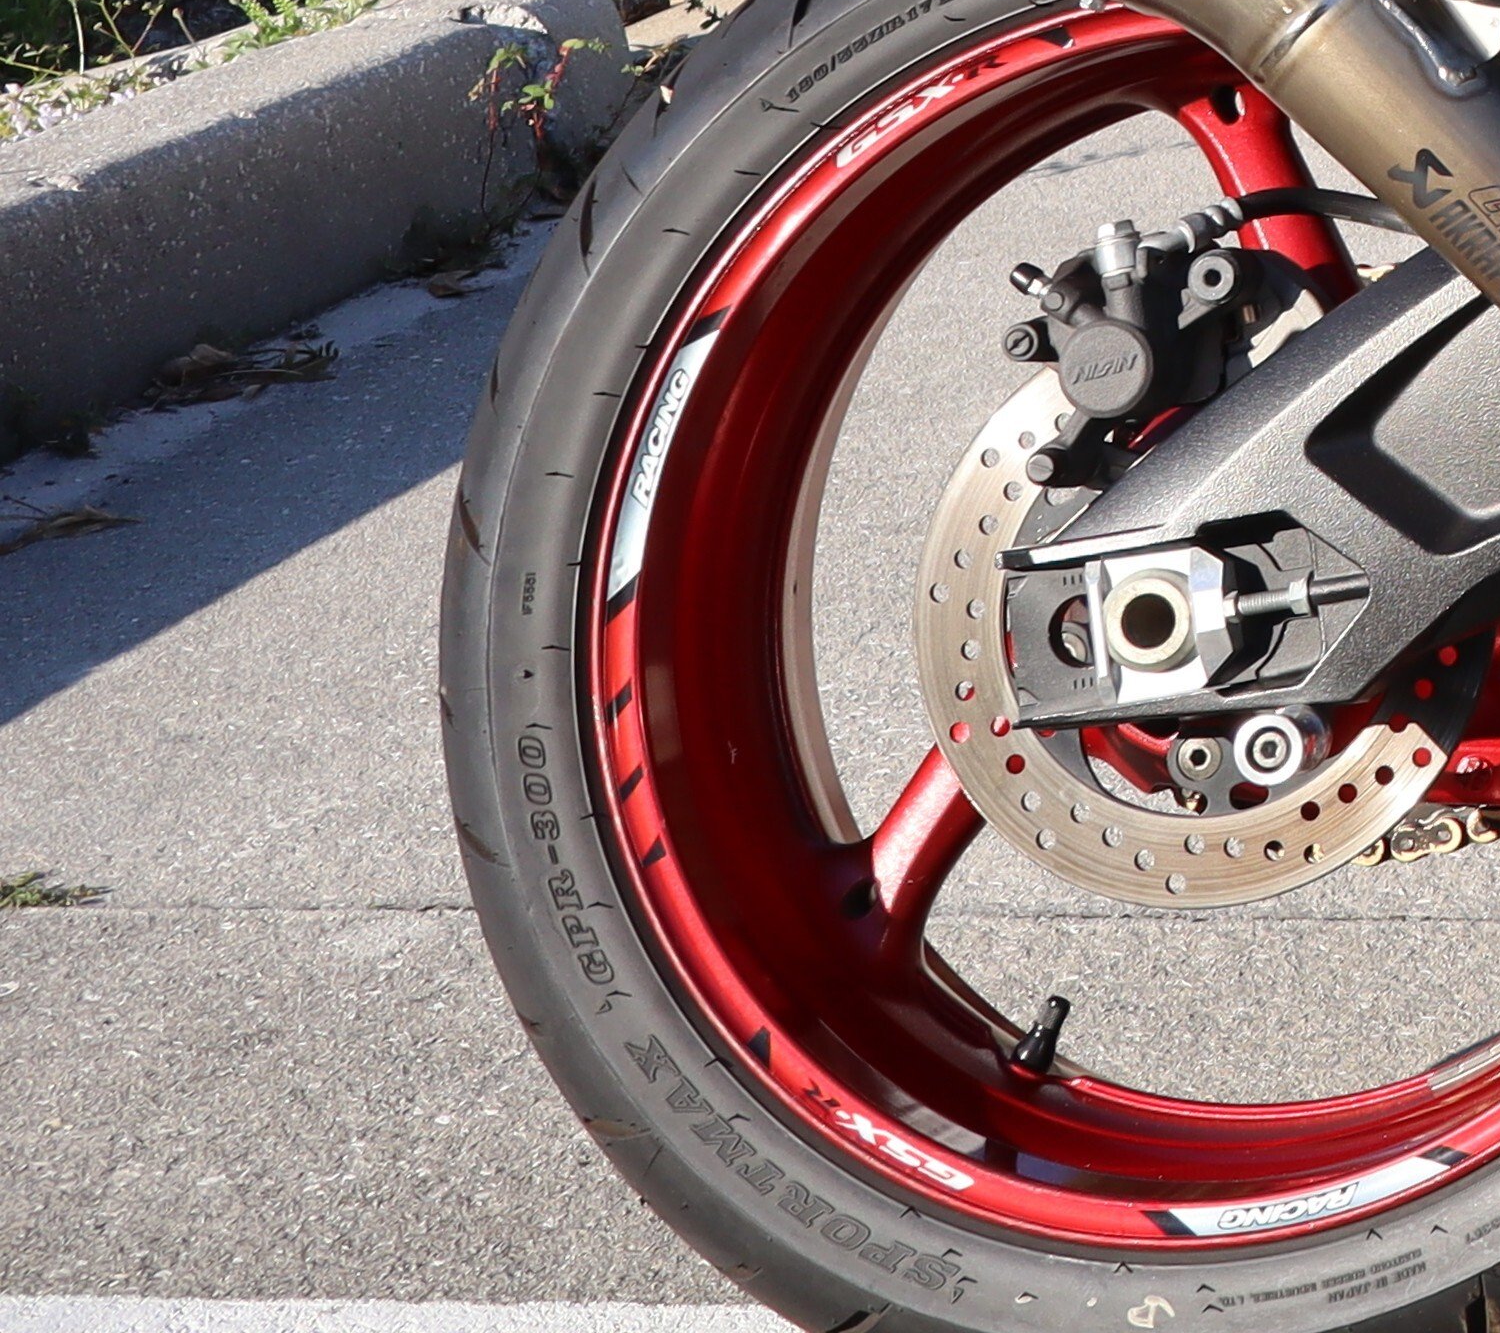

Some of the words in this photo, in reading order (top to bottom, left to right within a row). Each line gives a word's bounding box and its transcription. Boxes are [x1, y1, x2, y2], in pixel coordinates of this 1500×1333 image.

[836, 54, 1009, 169] GSX-R
[630, 367, 690, 510] RACING
[518, 734, 617, 986] GPR-300
[622, 1032, 961, 1292] SPORTMAX
[801, 1084, 976, 1193] GSX-R
[1216, 1181, 1360, 1230] RACING
